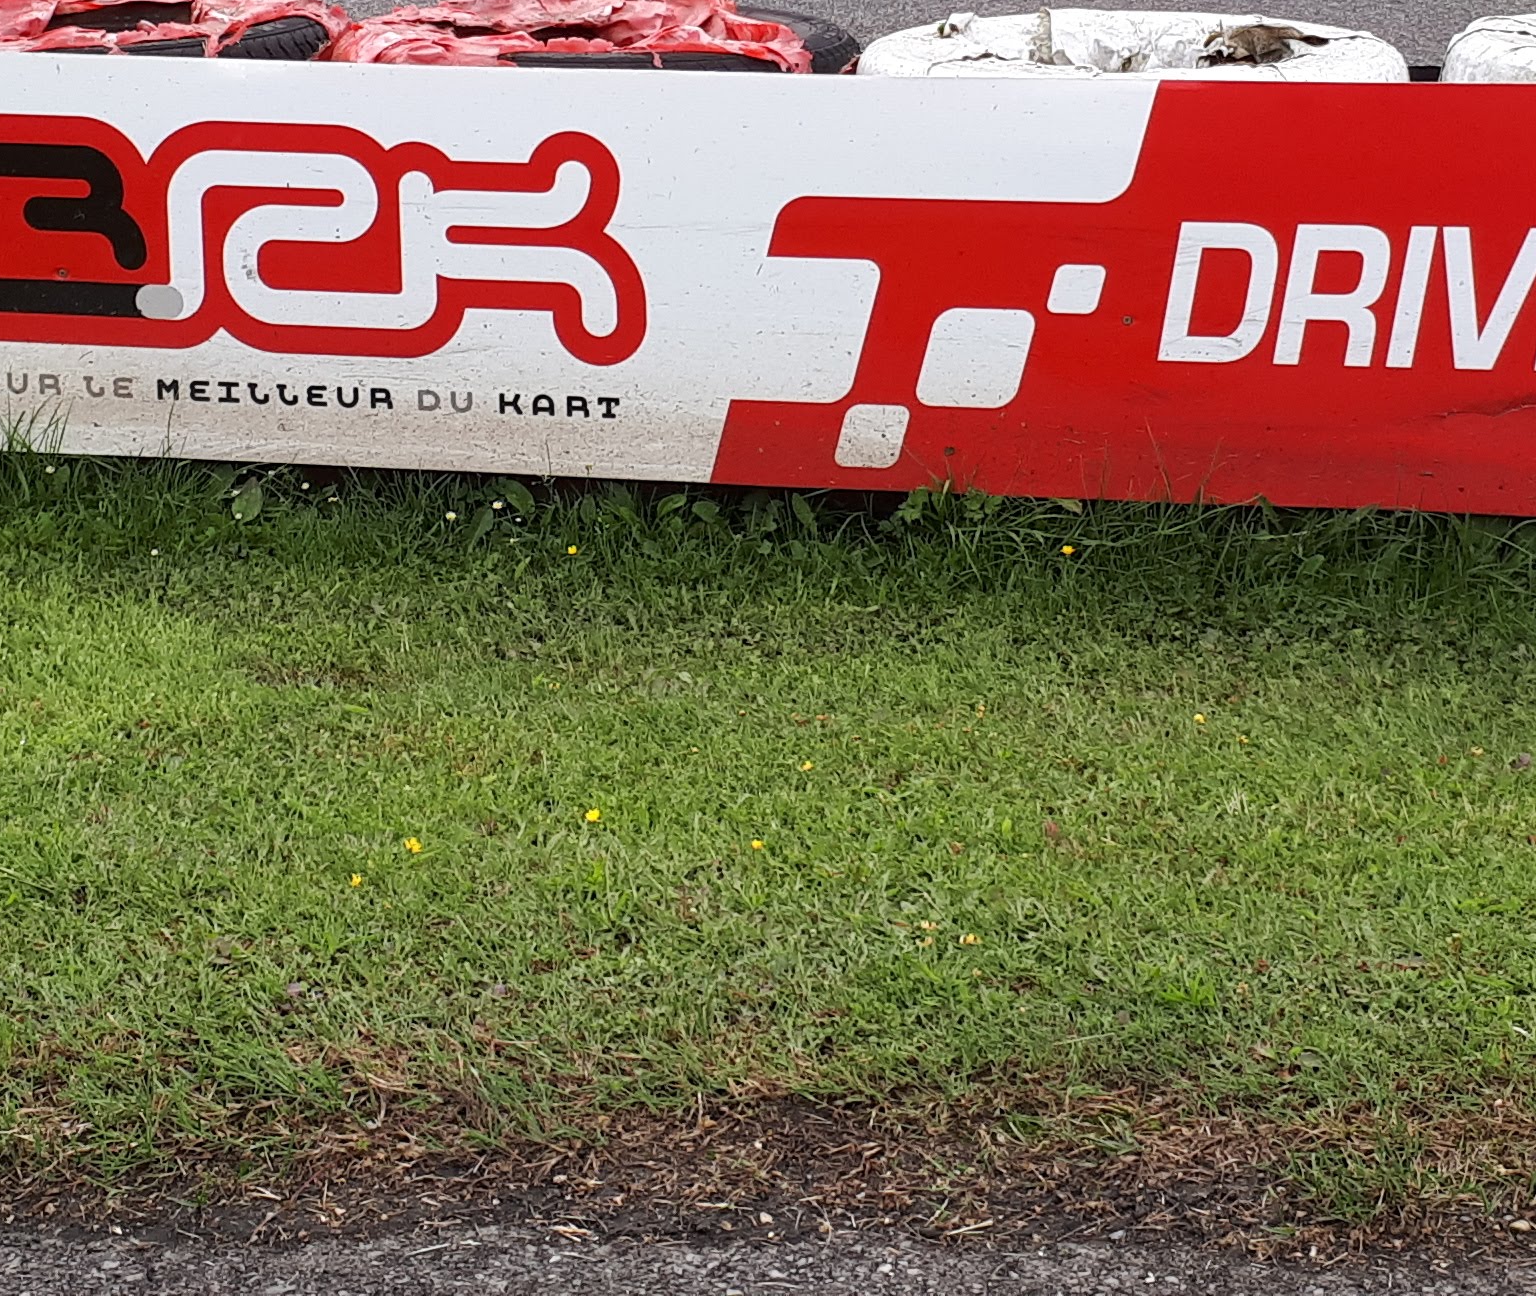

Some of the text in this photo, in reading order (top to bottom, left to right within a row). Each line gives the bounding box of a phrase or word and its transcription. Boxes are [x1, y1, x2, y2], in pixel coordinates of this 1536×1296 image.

[83, 375, 134, 398] LE
[156, 378, 394, 410] MEILLEUR
[417, 389, 474, 414] DU
[498, 392, 621, 419] KART
